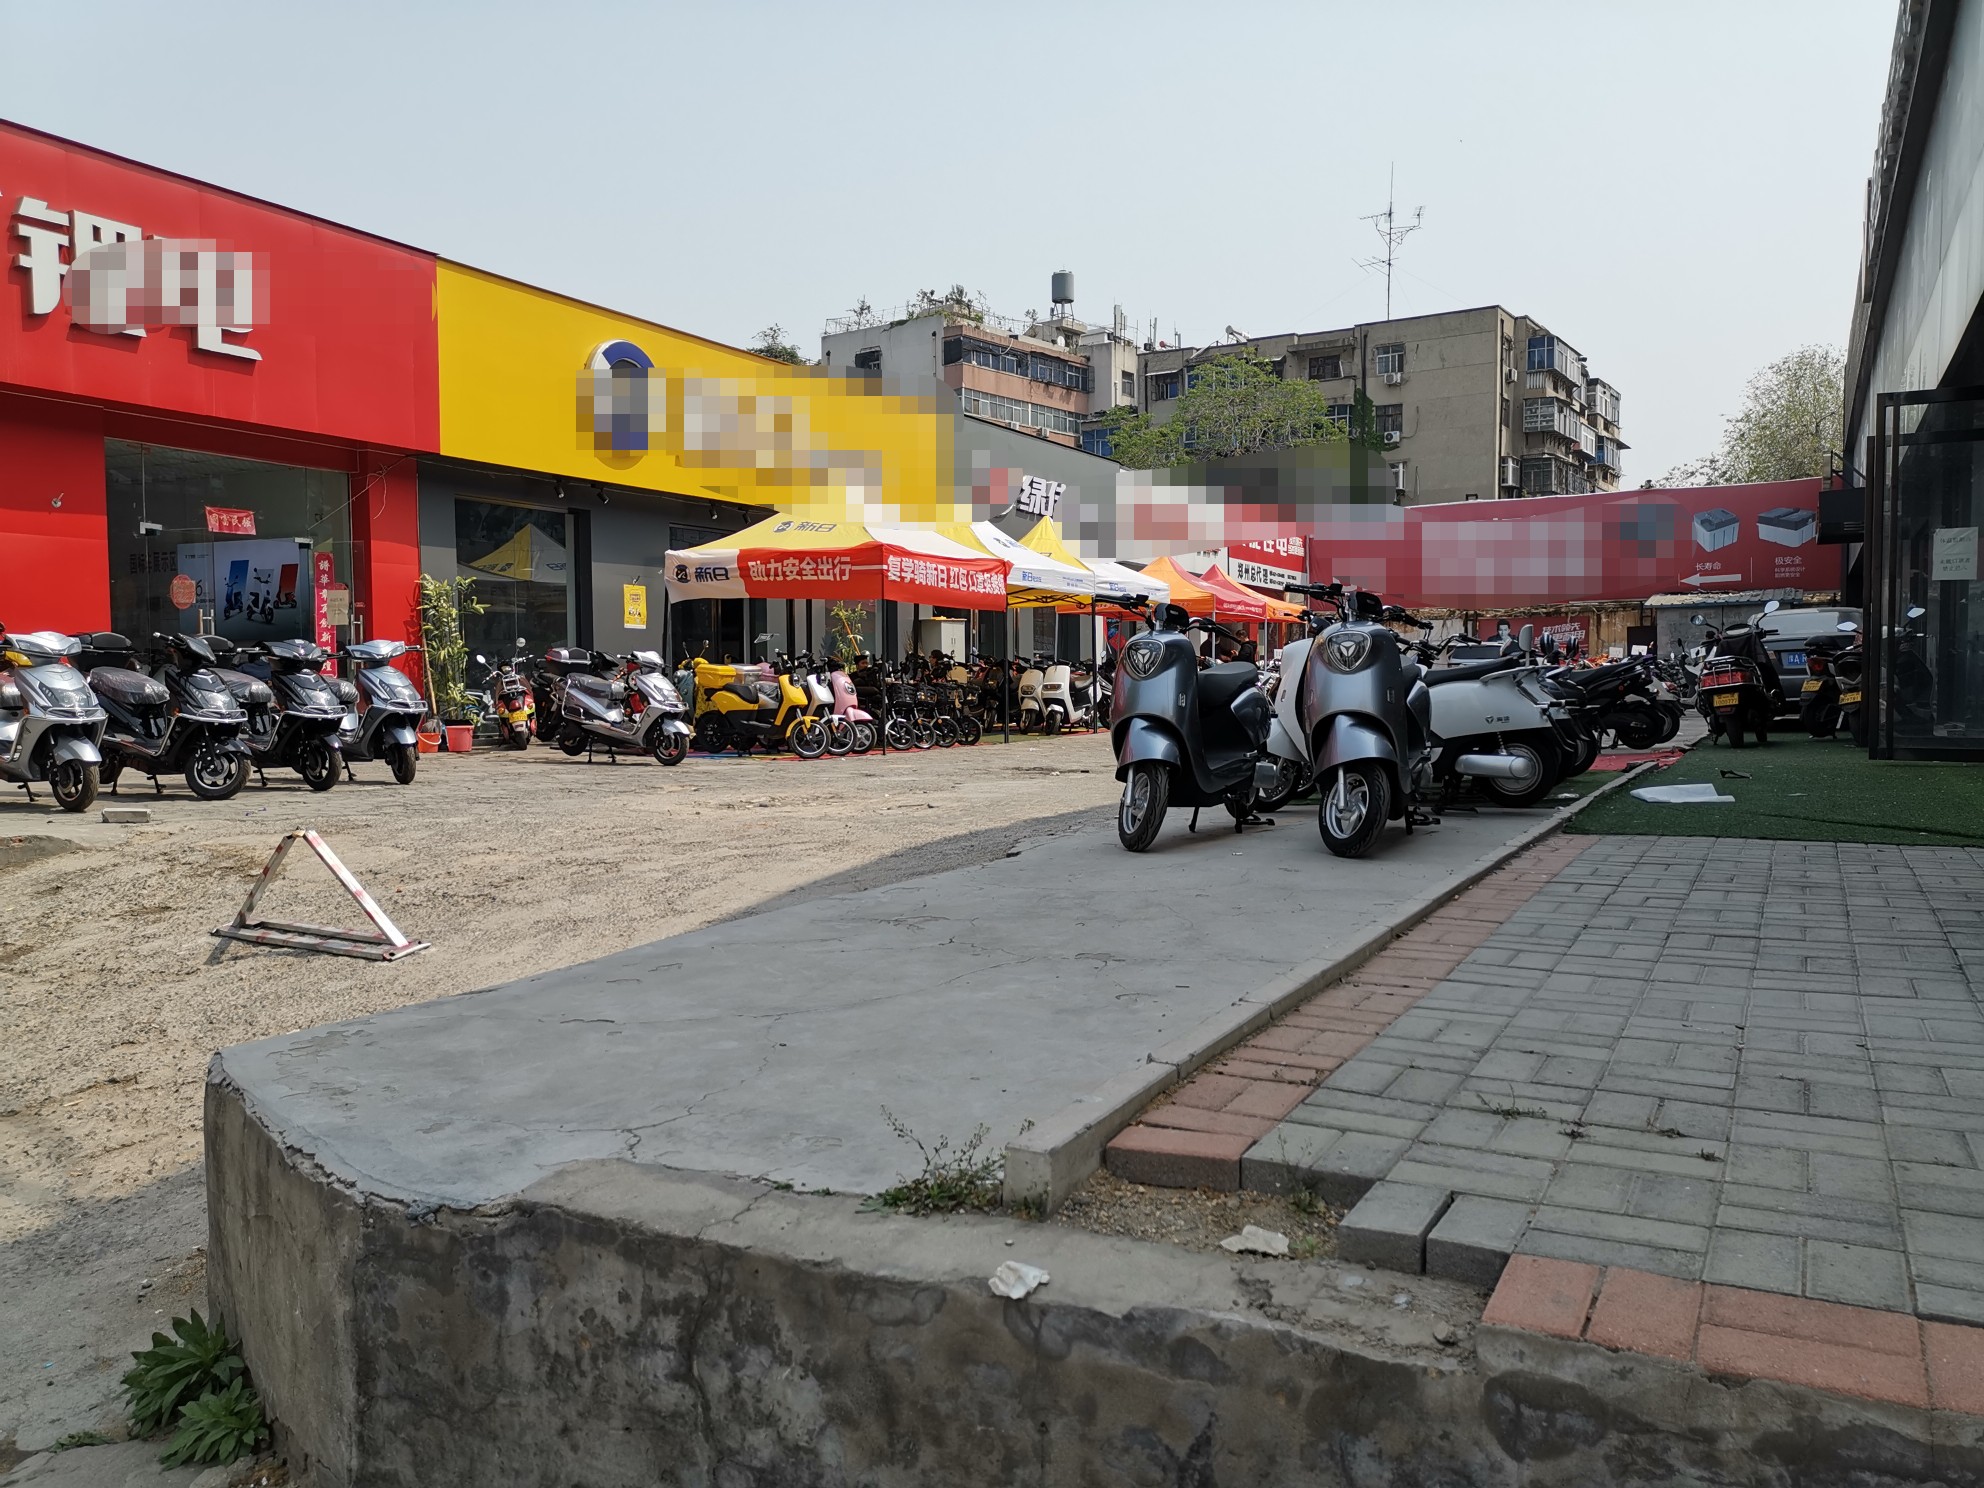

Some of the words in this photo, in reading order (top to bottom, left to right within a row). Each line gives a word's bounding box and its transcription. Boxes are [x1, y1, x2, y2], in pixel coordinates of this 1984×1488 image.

[794, 521, 836, 533] 新日
[1695, 561, 1722, 571] 长寿命
[1775, 556, 1803, 566] 极安全
[695, 566, 731, 583] 新日
